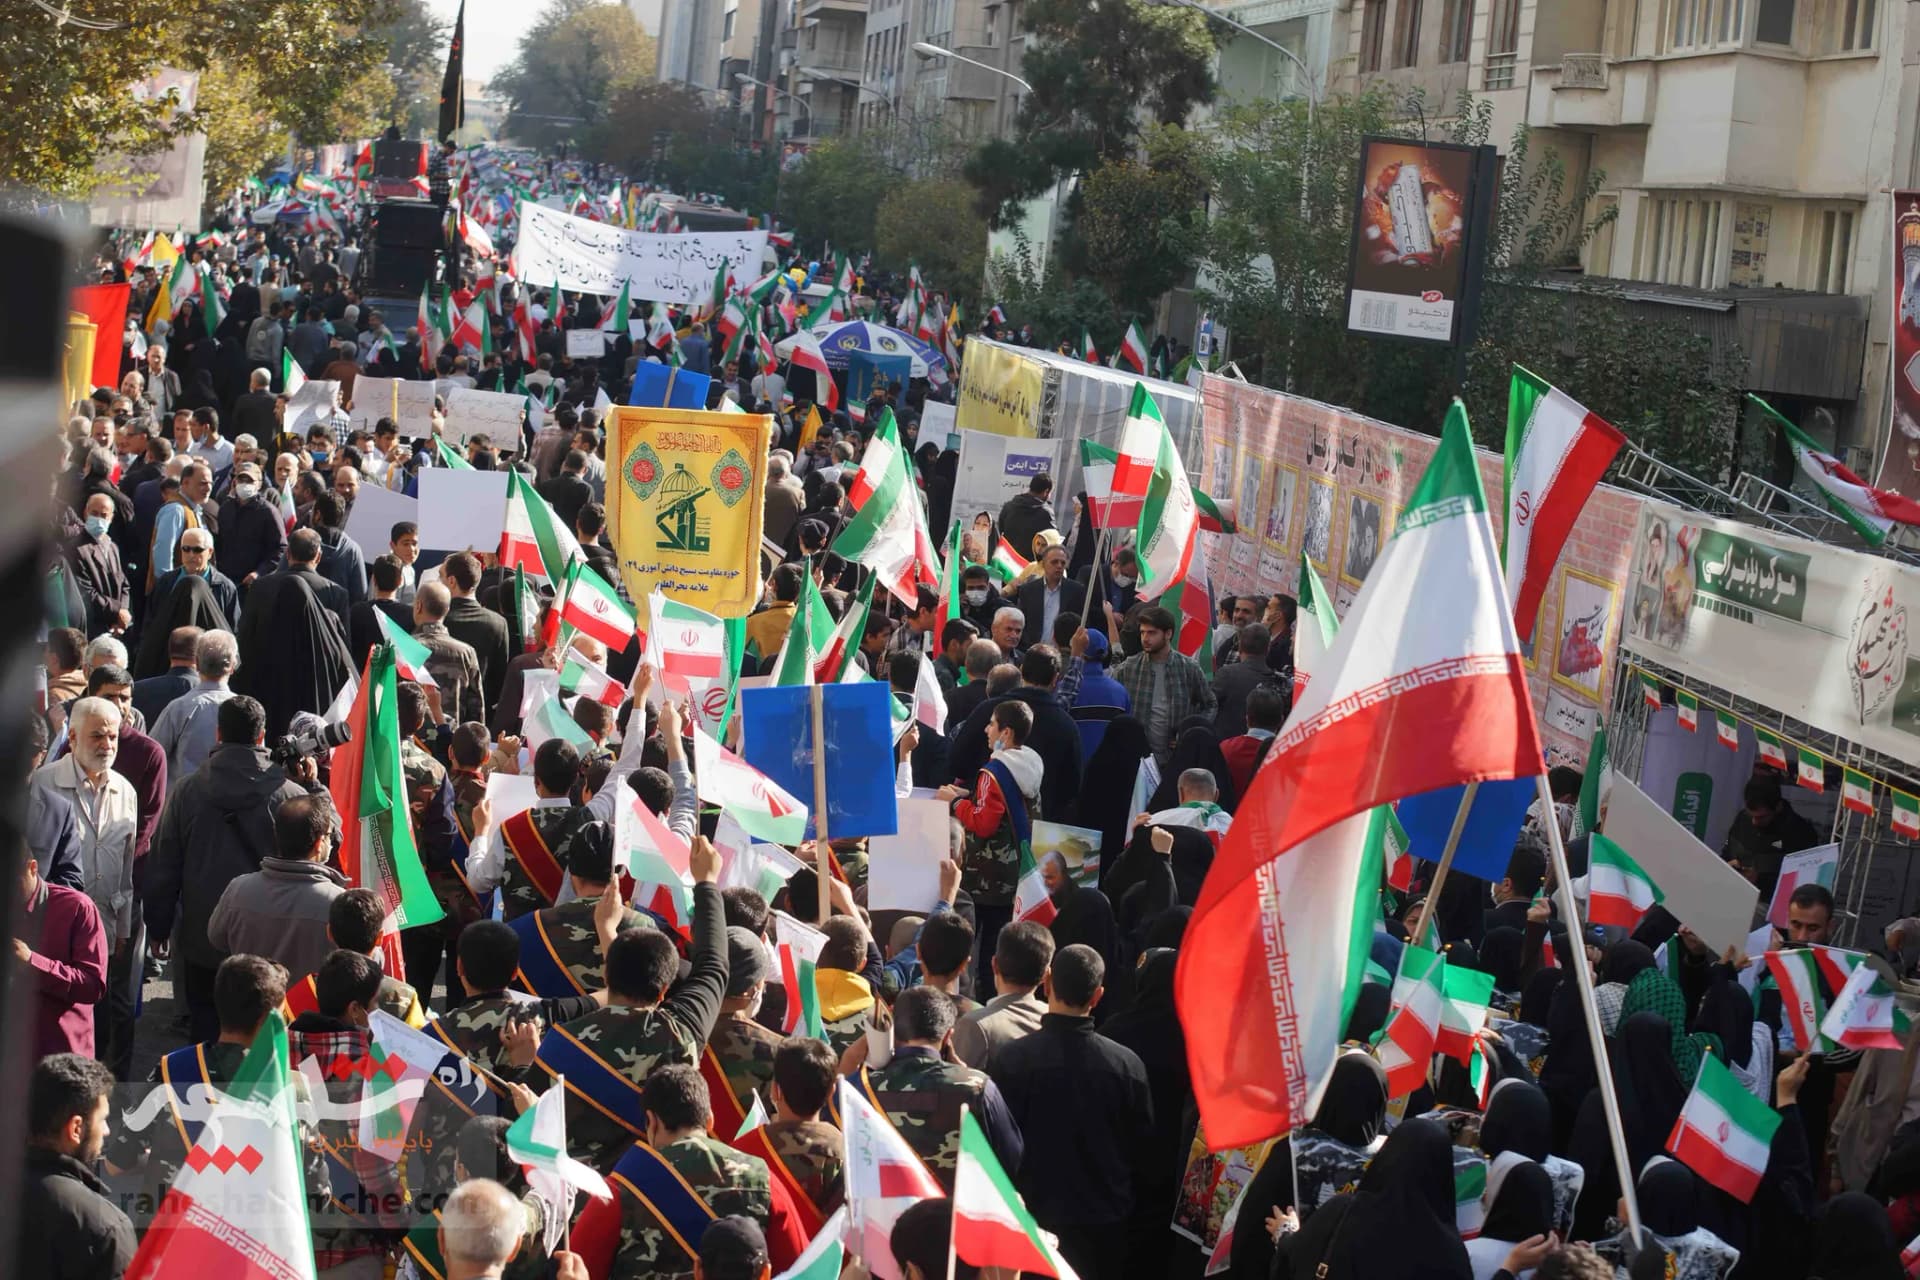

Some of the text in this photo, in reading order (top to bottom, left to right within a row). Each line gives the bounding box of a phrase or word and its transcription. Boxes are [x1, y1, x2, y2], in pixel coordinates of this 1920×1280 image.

[1006, 460, 1049, 472] پلاک ایمن
[638, 561, 661, 573] آموزی
[661, 563, 679, 574] دانش
[678, 567, 697, 576] بسیج
[698, 566, 723, 578] مقاومت
[723, 566, 740, 579] حوزه
[1702, 542, 1797, 605] موکب پذیرایی
[690, 582, 709, 592] علامه
